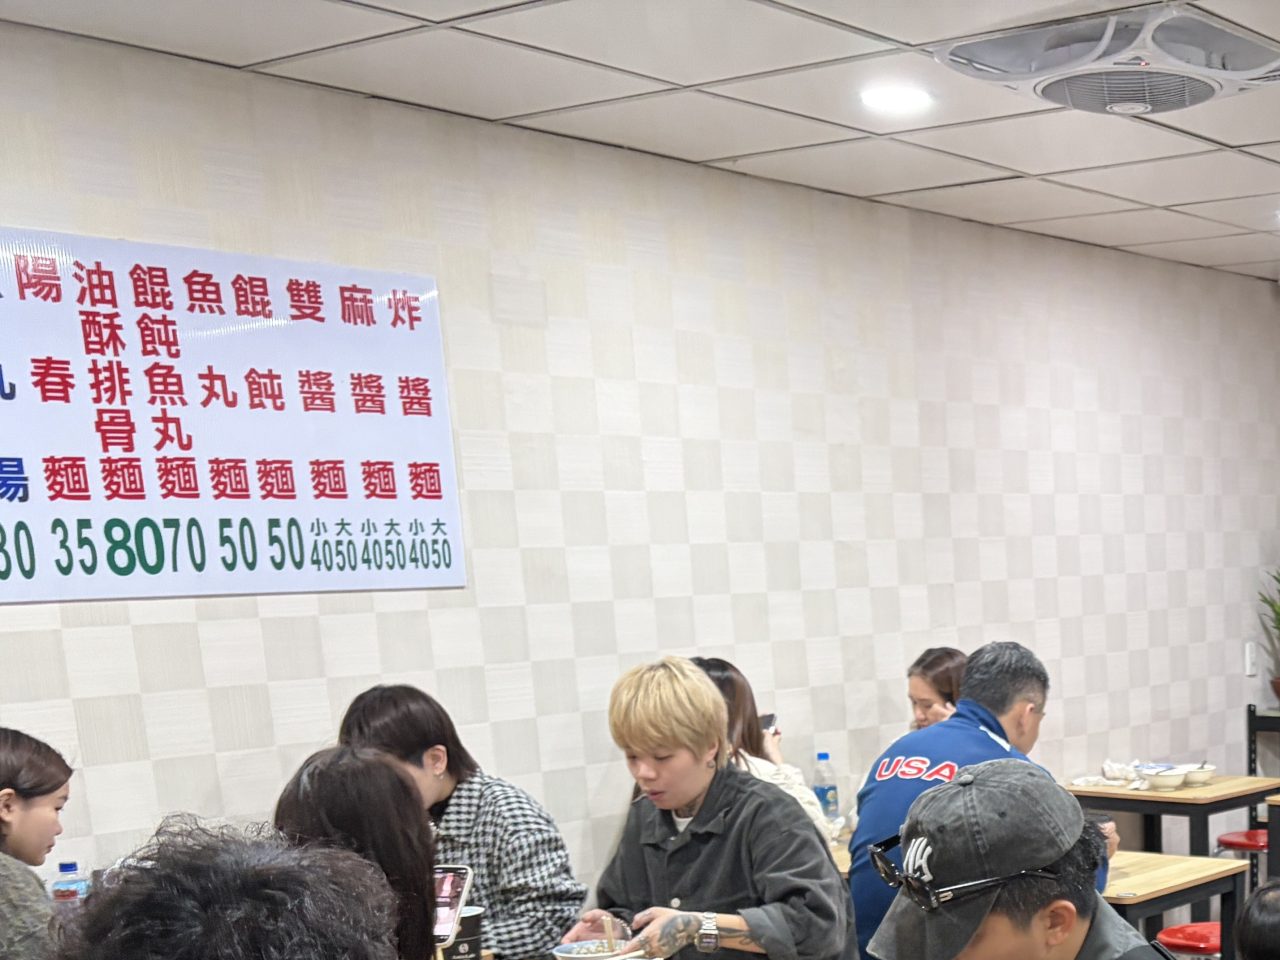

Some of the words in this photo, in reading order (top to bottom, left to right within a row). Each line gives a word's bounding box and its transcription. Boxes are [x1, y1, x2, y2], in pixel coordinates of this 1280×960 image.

[14, 254, 91, 501] 陽春麵
[72, 261, 146, 501] 油酥排骨麵
[128, 263, 200, 500] 餛飩魚丸麵
[182, 269, 251, 500] 魚丸麵
[230, 274, 298, 500] 餛飩麵
[310, 518, 328, 537] 小
[334, 518, 353, 537] 大
[361, 518, 378, 537] 小
[384, 518, 401, 537] 大
[408, 518, 425, 537] 小
[431, 518, 448, 537] 大
[51, 518, 98, 575] 35
[104, 518, 165, 576] 80
[163, 518, 207, 572] 70
[218, 518, 259, 571] 50
[267, 518, 305, 571] 50
[310, 539, 333, 571] 40
[335, 540, 357, 571] 50
[361, 539, 383, 570] 40
[385, 539, 406, 570] 50
[409, 538, 430, 569] 40
[431, 539, 452, 569] 50
[876, 756, 958, 782] USA
